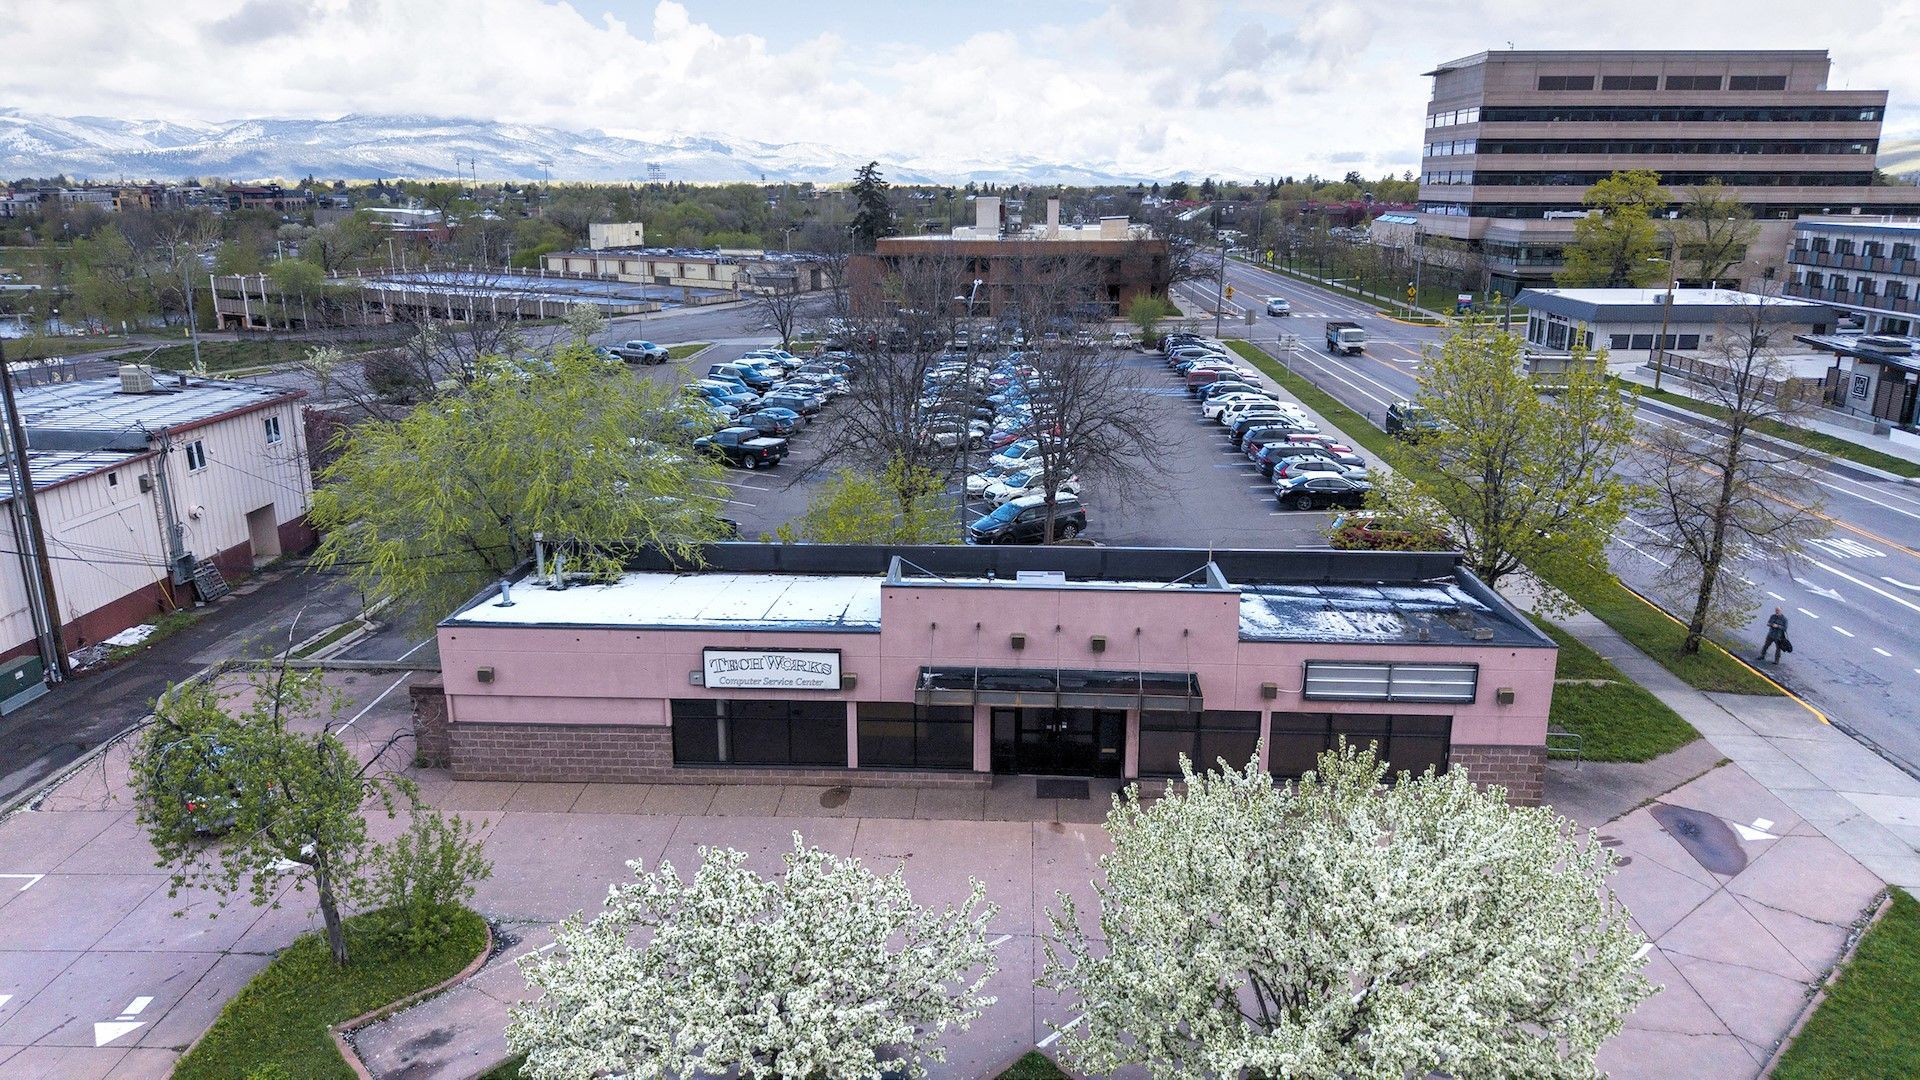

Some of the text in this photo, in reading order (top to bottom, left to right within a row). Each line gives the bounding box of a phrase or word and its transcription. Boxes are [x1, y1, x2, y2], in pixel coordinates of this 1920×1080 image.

[719, 676, 824, 686] Computer Service Center
